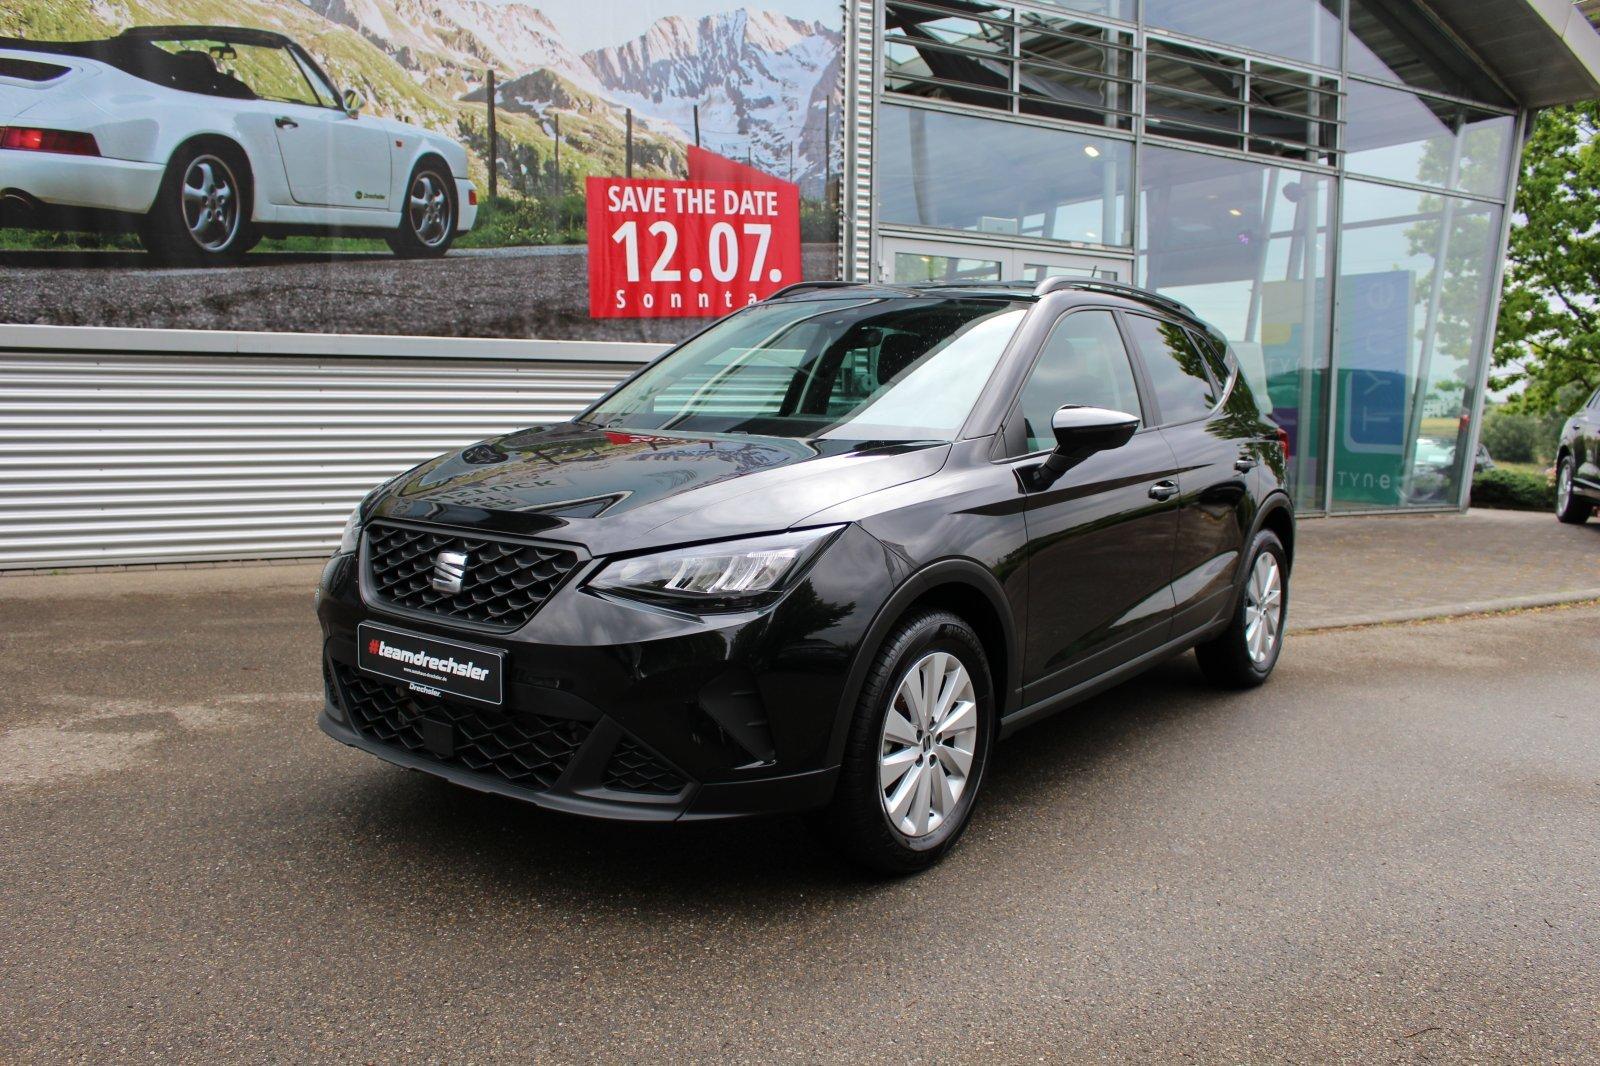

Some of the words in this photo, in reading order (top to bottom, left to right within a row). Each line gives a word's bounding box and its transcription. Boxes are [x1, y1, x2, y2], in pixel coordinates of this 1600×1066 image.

[608, 186, 666, 213] SAVE
[673, 188, 716, 215] THE
[724, 190, 778, 216] DATE
[611, 220, 783, 283] 12.07.
[616, 289, 759, 309] Sonnta
[368, 639, 489, 681] #teamdrechsler
